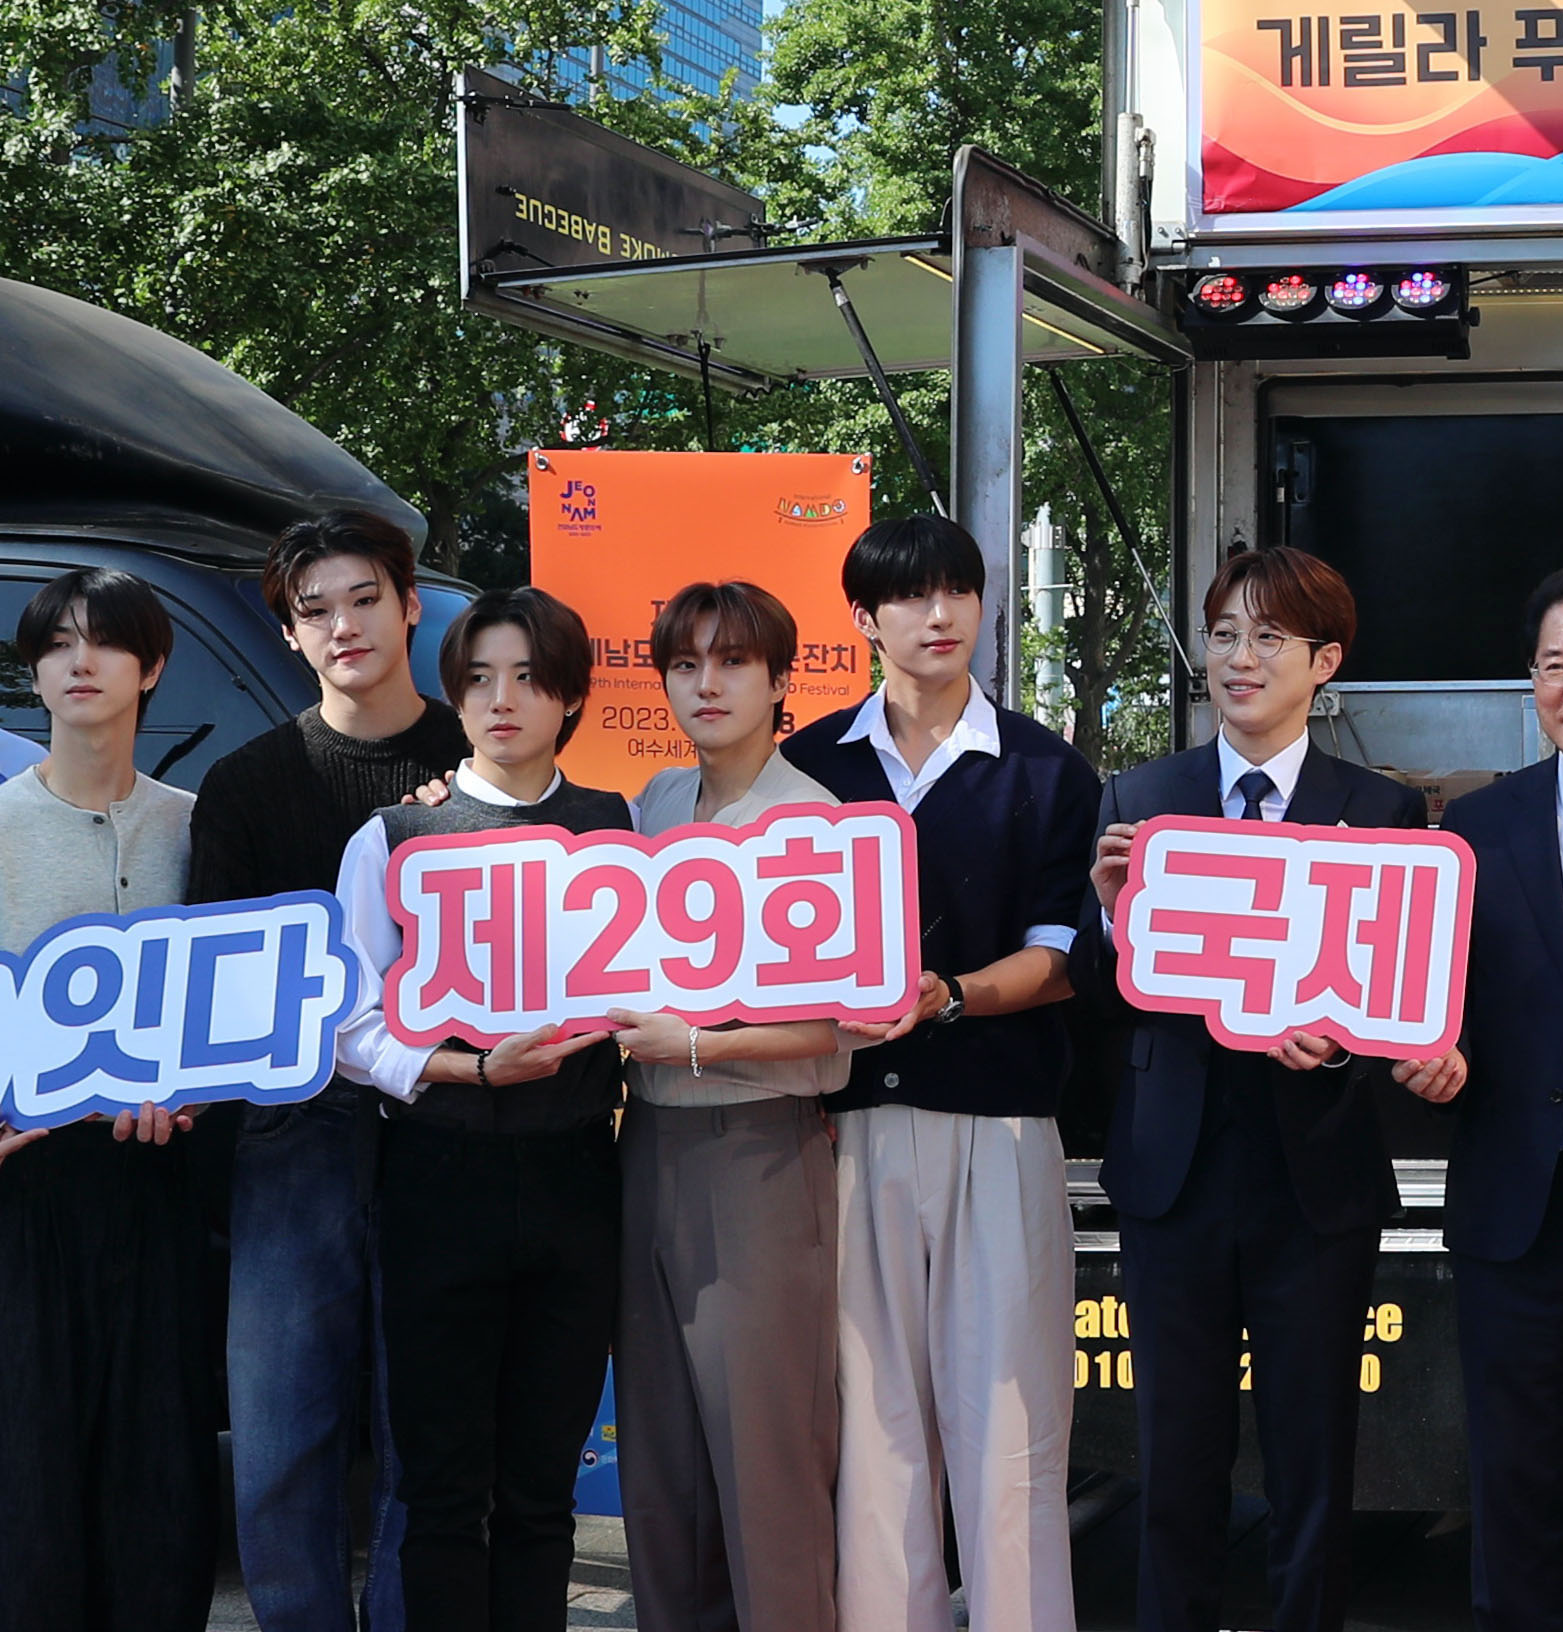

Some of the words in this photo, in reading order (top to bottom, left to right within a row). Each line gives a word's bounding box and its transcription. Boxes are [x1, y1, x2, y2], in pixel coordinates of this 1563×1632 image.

[1256, 9, 1488, 88] 게릴라
[514, 193, 612, 256] BABECUE
[777, 497, 846, 518] NAMDO
[614, 678, 663, 691] Interna
[800, 682, 850, 696] Festival
[789, 643, 857, 674] 잔치
[602, 706, 676, 731] 2023.
[420, 836, 885, 1013] 제29회
[1149, 850, 1439, 1023] 국제
[35, 922, 325, 1096] 잇다
